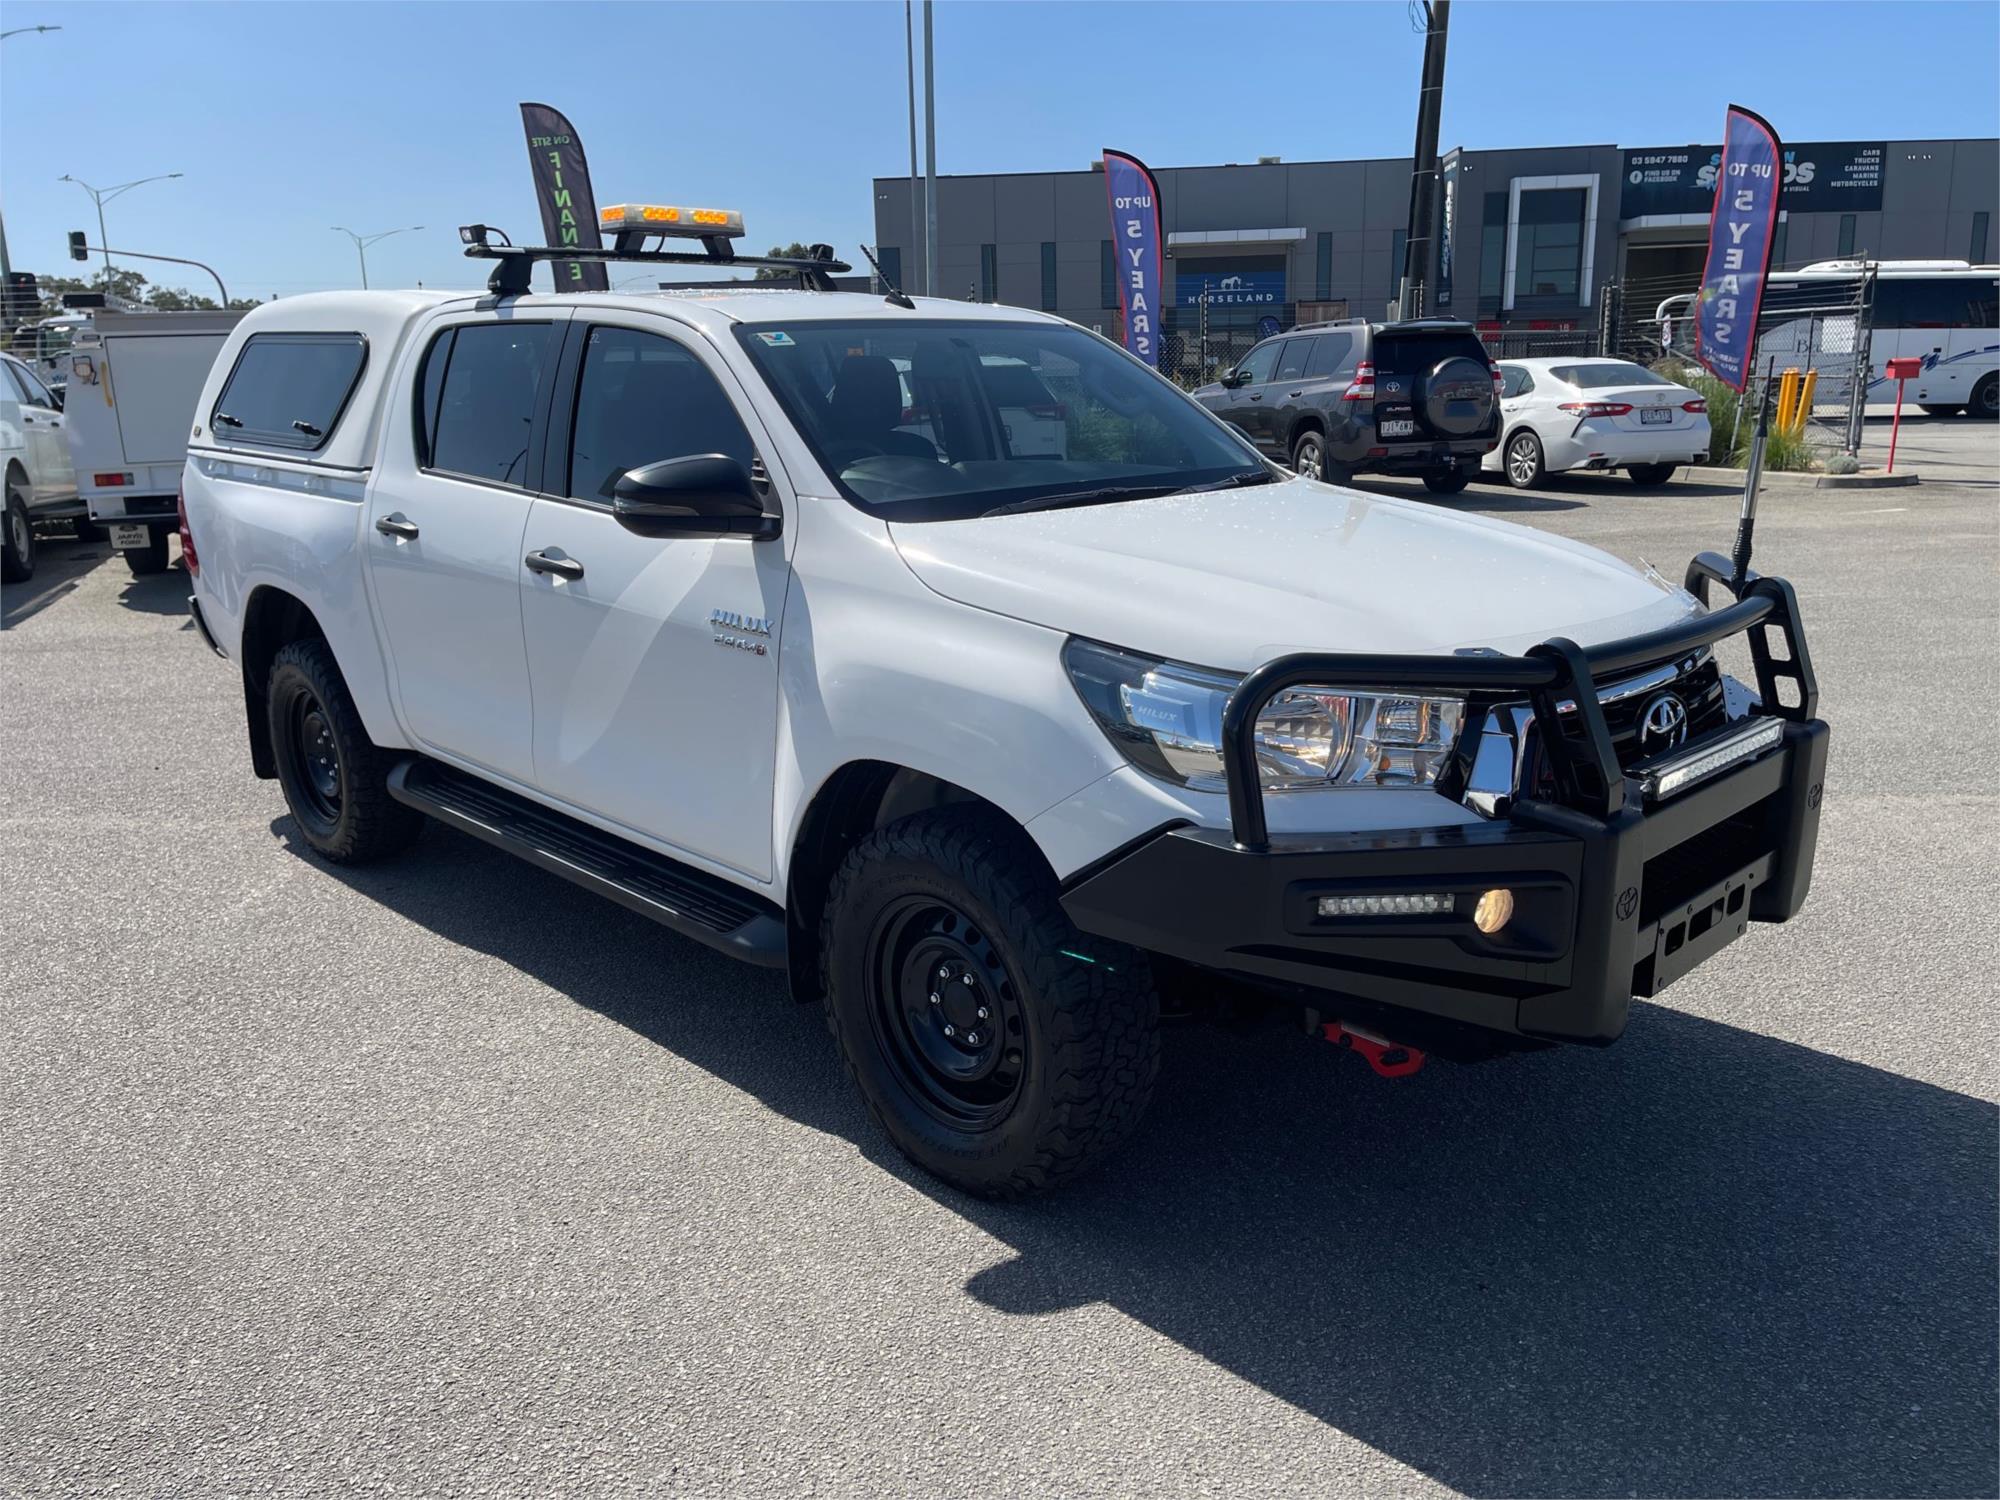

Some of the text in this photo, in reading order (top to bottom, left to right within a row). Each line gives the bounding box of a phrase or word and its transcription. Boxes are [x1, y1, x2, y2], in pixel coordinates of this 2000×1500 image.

[1631, 156, 1643, 165] 03
[1844, 164, 1879, 172] CARAVANS
[1830, 180, 1878, 188] MOTORCYCLES
[1137, 705, 1177, 722] HILUX
